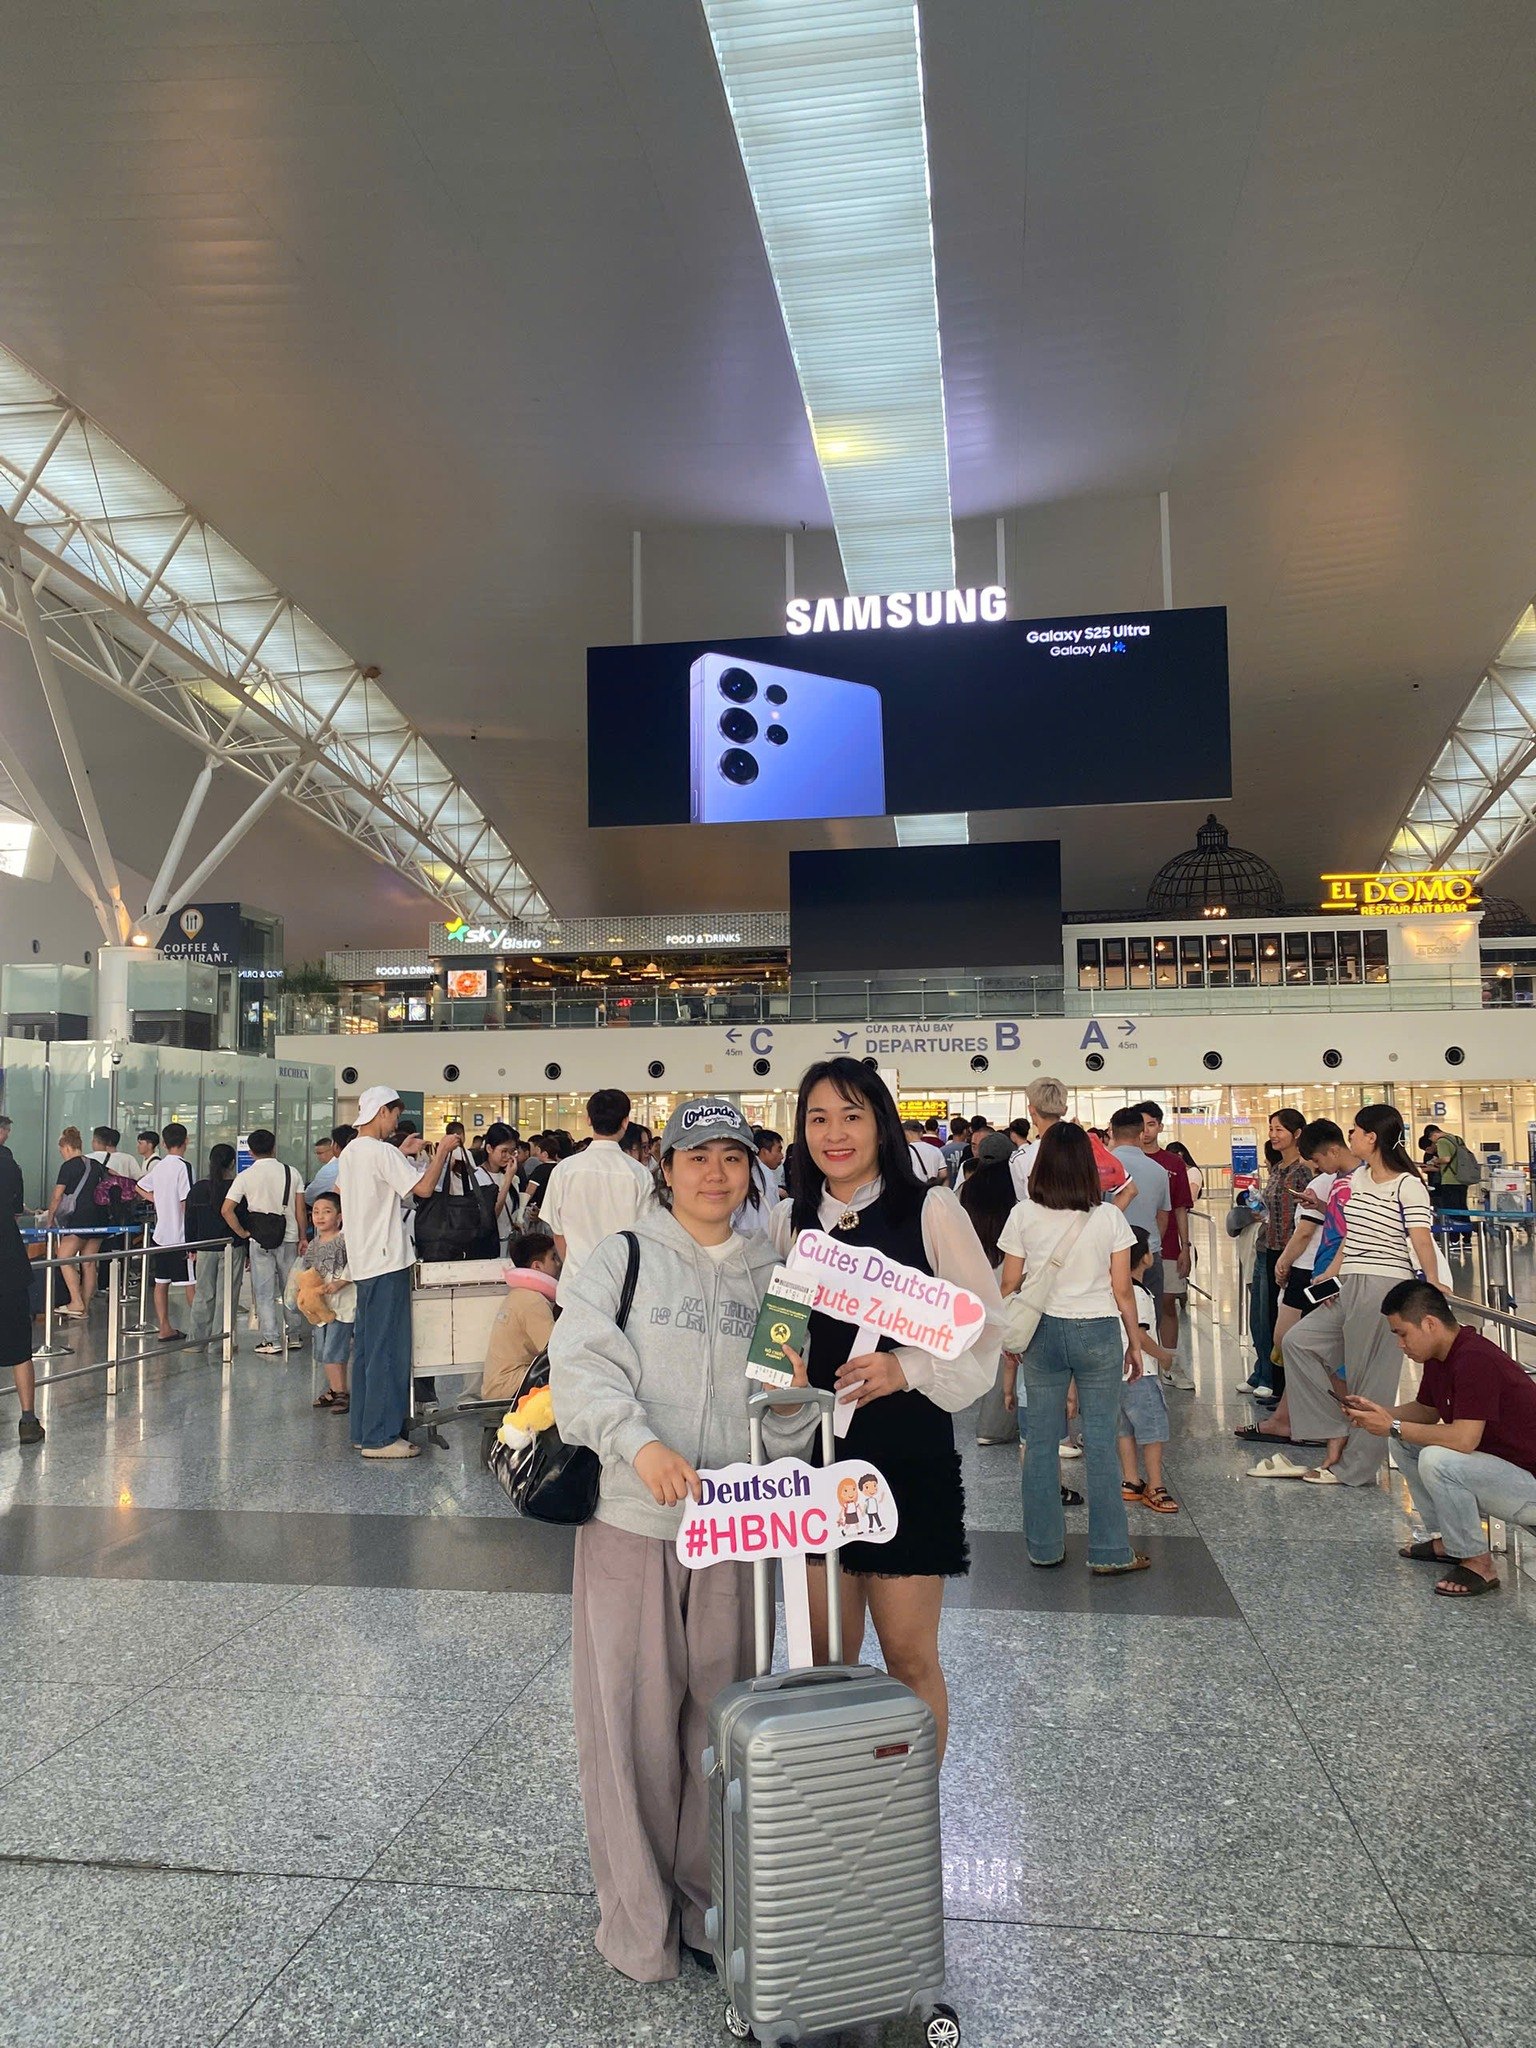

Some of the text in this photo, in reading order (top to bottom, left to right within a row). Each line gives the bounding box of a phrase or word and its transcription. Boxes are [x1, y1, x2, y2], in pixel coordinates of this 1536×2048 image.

[785, 585, 1008, 636] SAMSUNG
[1026, 624, 1150, 644] Galaxy S25 Ultra
[1050, 643, 1111, 657] Galaxy AI
[1331, 878, 1473, 904] EL DOMO
[1360, 903, 1433, 916] RESTAURANT
[1443, 902, 1468, 914] BAR
[464, 926, 542, 950] sky Bistro
[666, 932, 741, 945] FOOD & DRINKS
[162, 952, 229, 963] ESTAURANT
[163, 942, 221, 954] COFFEE &
[376, 966, 401, 976] FOOD
[402, 965, 408, 976] &
[891, 1023, 907, 1034] RA
[908, 1020, 931, 1033] TÀU
[933, 1022, 955, 1033] BAY
[1079, 1020, 1109, 1050] A
[749, 1027, 774, 1056] C
[865, 1036, 989, 1054] DEPARTURES
[995, 1022, 1021, 1052] B
[1118, 1042, 1138, 1050] 45m
[725, 1047, 743, 1057] 45m
[683, 1105, 737, 1128] Orlando
[1434, 1101, 1447, 1117] B
[474, 1113, 485, 1127] B
[797, 1232, 859, 1275] Gutes
[862, 1255, 951, 1310] Deutsch
[863, 1296, 955, 1354] Zukunft
[697, 1469, 812, 1507] Deutsch
[685, 1507, 829, 1559] #HBNC
